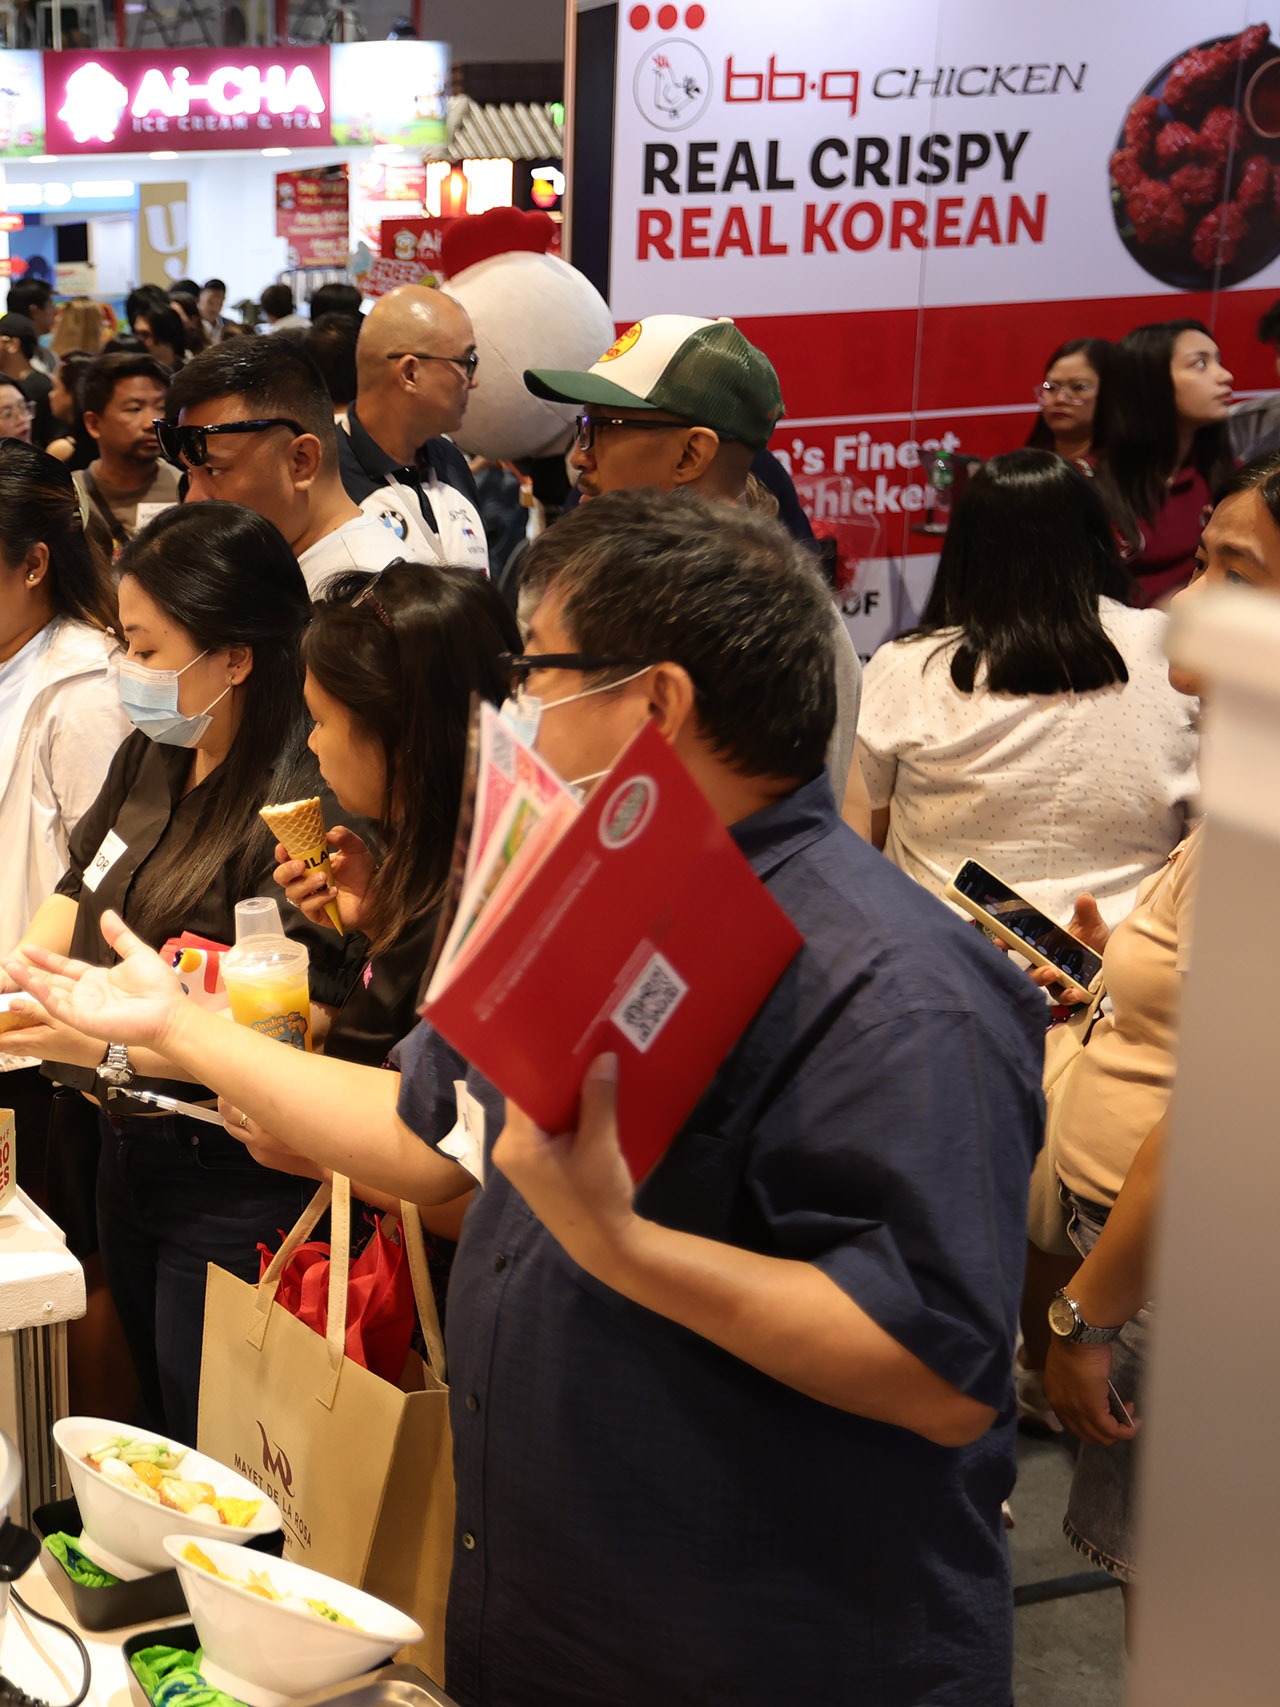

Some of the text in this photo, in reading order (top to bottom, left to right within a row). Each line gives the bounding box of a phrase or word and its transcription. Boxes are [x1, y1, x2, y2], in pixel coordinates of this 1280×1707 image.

[131, 65, 326, 118] Ai-CHA
[871, 62, 1088, 100] CHICKEN
[132, 113, 322, 132] ICE CREAM & TEA
[643, 130, 1031, 195] REAL CRISPY
[636, 193, 1048, 261] REAL KOREAN
[234, 1453, 264, 1490] MAYET
[266, 1483, 279, 1506] DE
[282, 1496, 292, 1519] LA
[294, 1511, 312, 1549] ROSA
